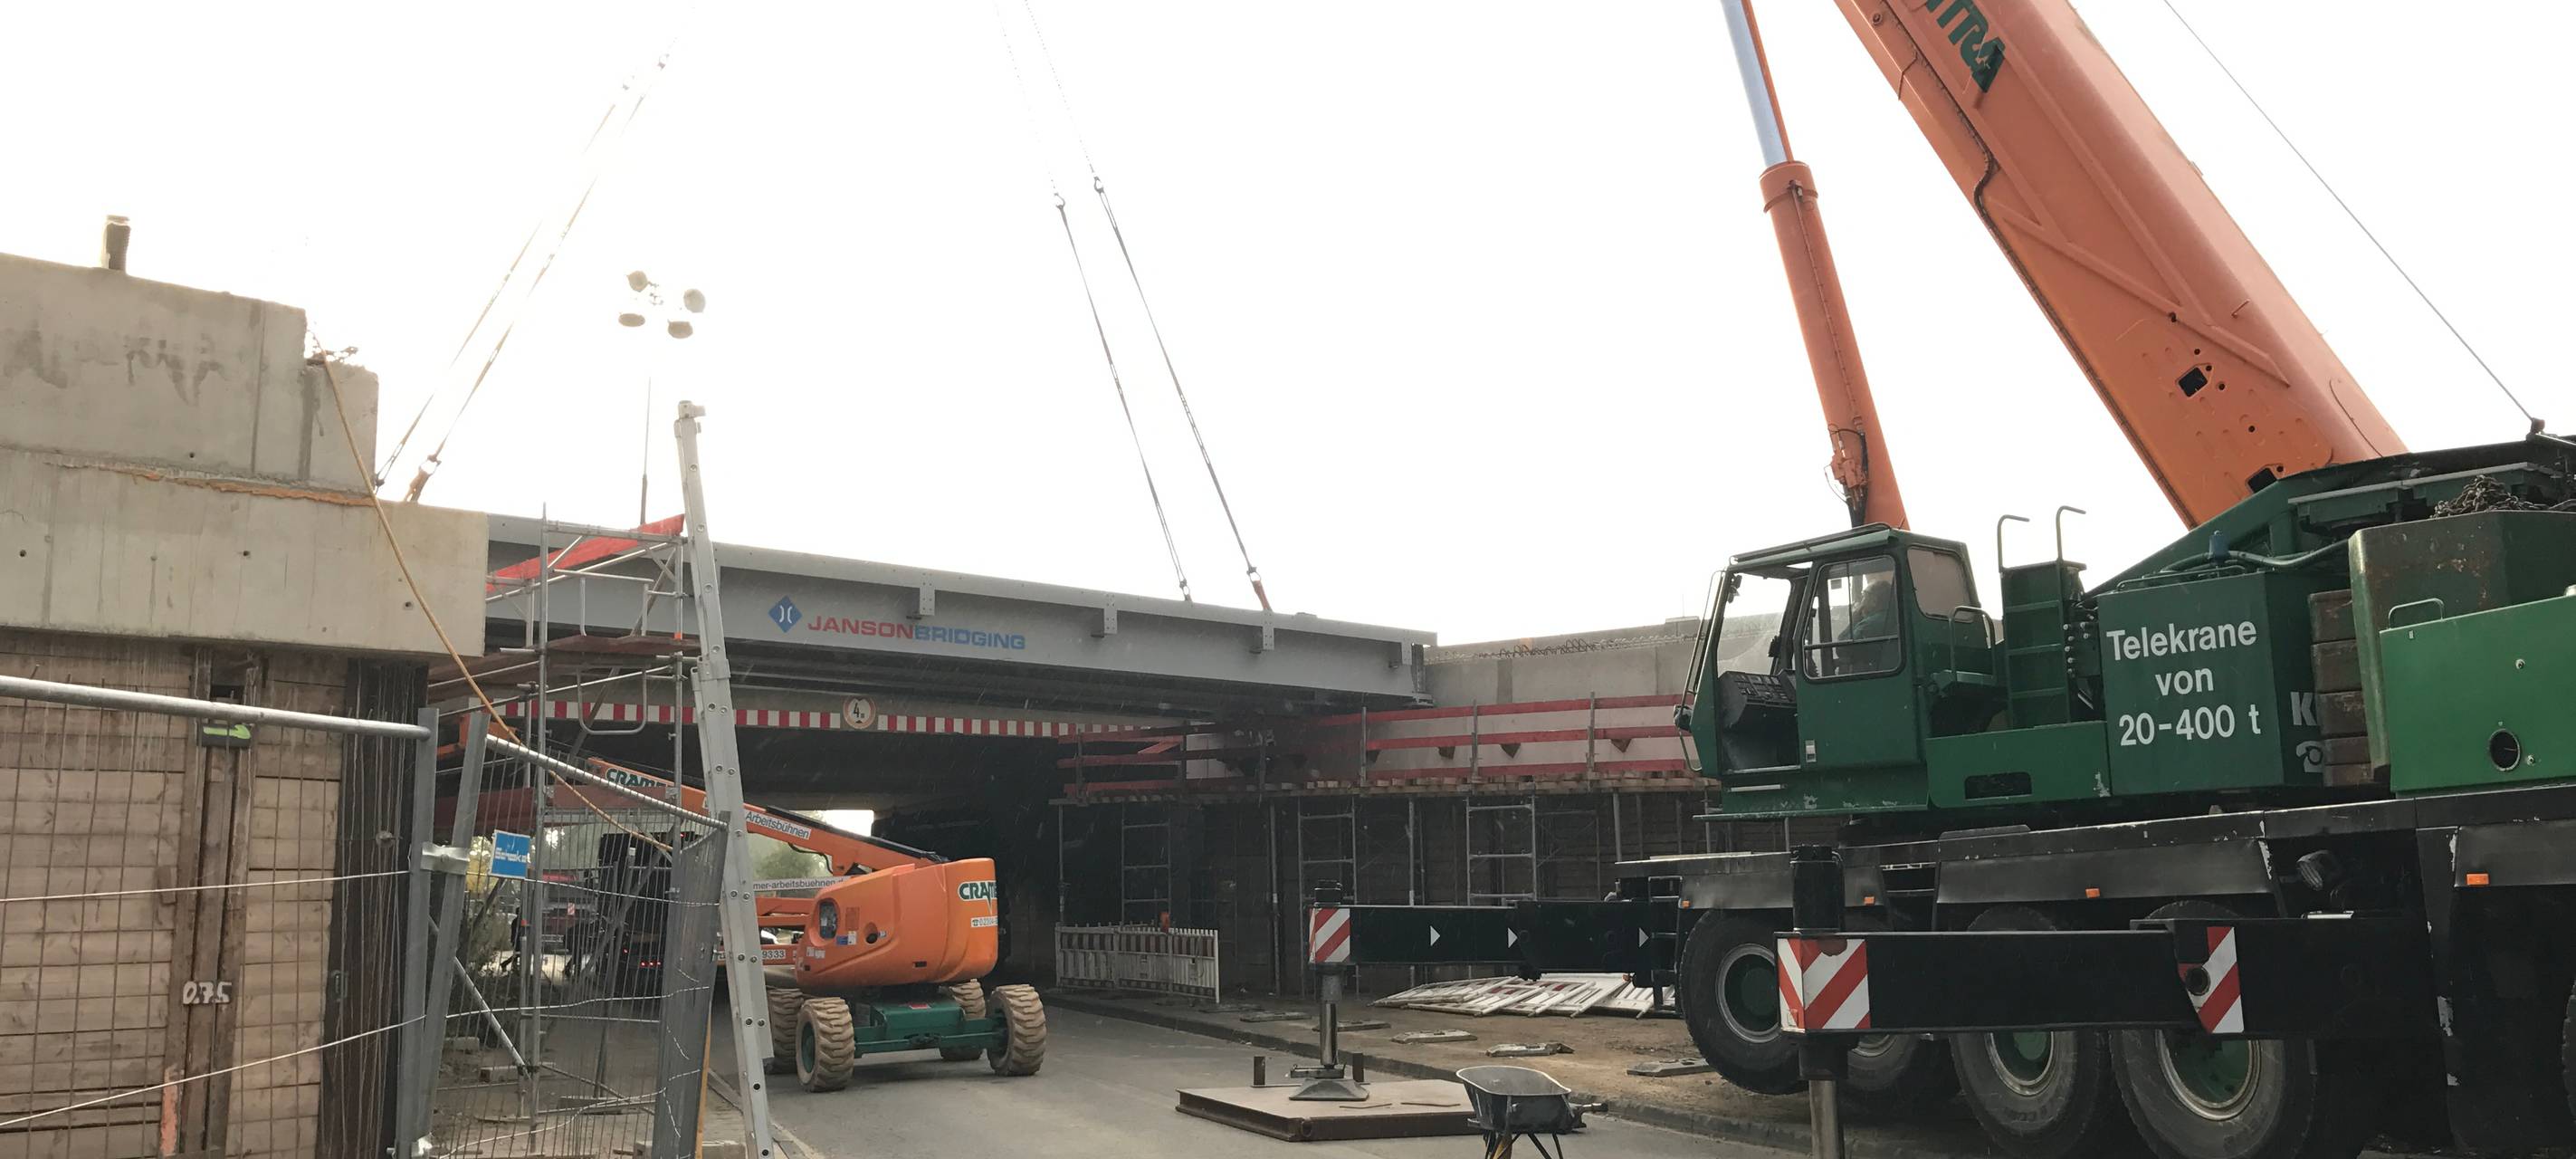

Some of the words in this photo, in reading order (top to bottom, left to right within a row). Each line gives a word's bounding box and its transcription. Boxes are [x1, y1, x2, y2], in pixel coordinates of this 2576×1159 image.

[807, 616, 1026, 650] JANSONBRIDGING
[2106, 620, 2257, 661] Telekrane
[2155, 667, 2214, 696] von
[2119, 704, 2236, 746] 20-400
[2248, 704, 2261, 734] t
[606, 767, 667, 789] CRAM
